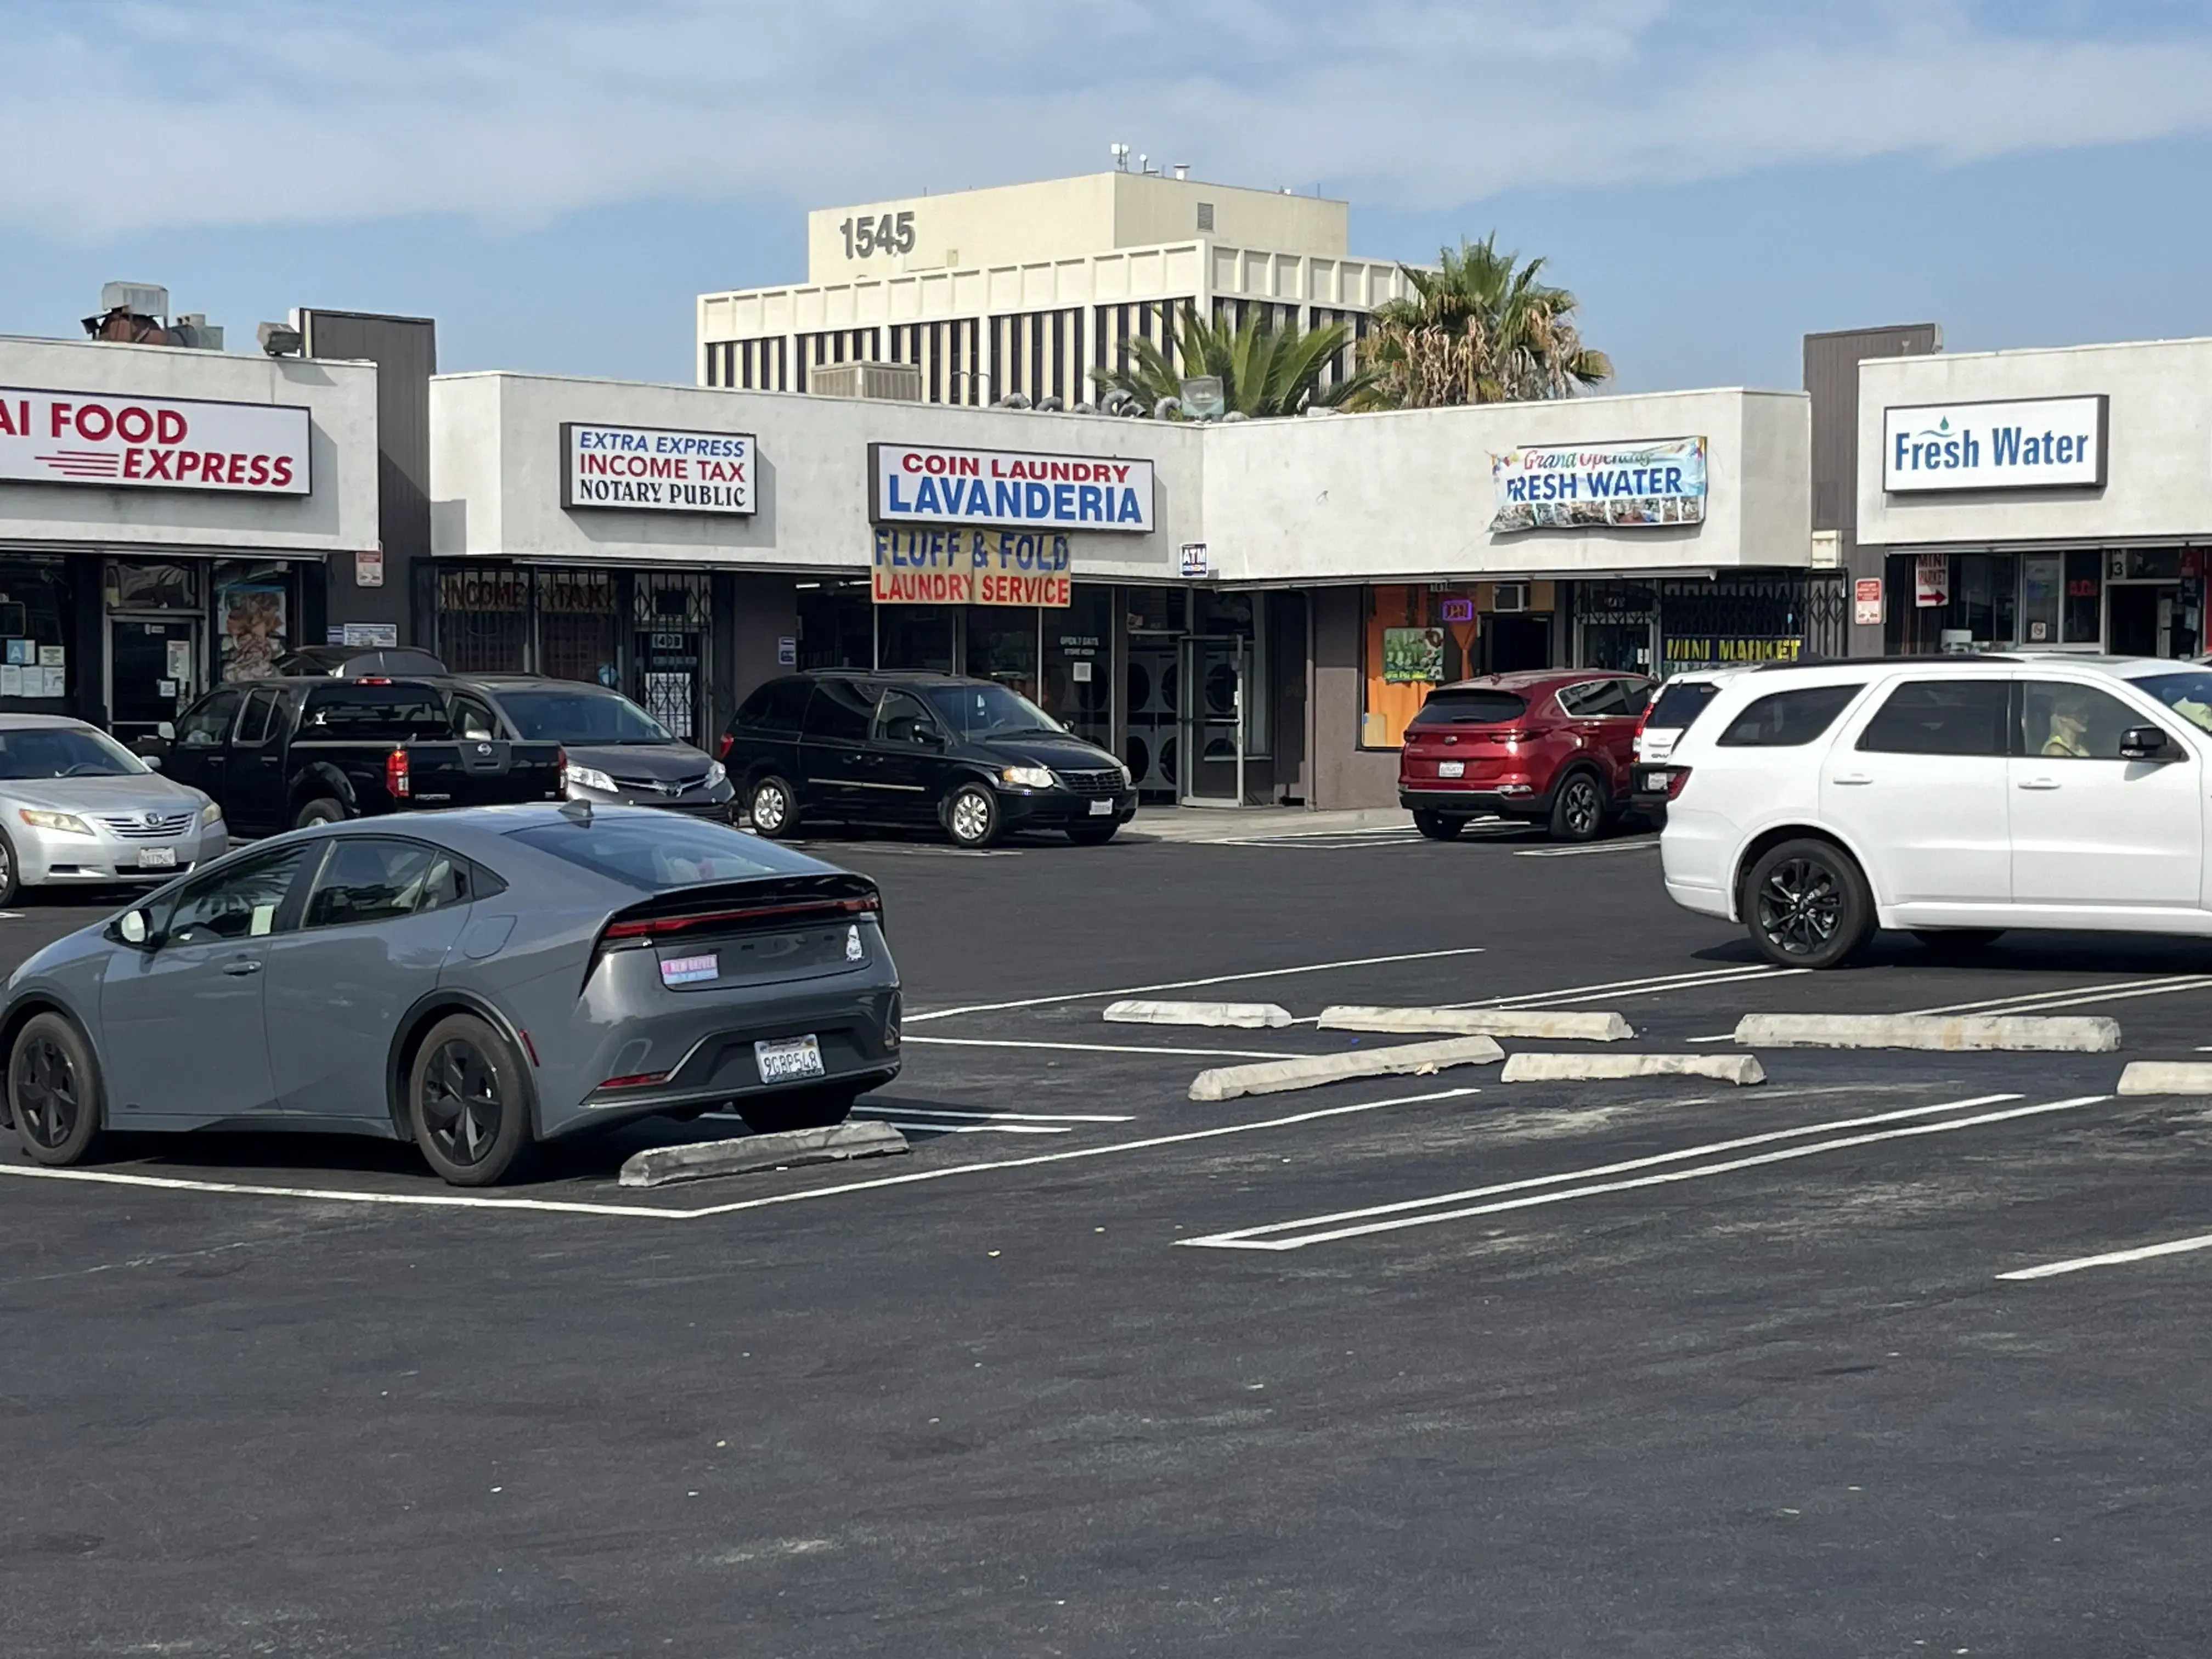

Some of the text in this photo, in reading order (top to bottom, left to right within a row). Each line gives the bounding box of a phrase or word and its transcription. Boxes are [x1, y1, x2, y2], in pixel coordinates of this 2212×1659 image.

[840, 211, 916, 259] 1545
[52, 402, 187, 445] FOOD
[579, 431, 746, 457] EXTRA EXPRESS
[1895, 426, 2089, 470] Fresh Water
[123, 448, 294, 487] EXPRESS
[580, 454, 746, 482] INCOME TAX
[902, 453, 1131, 483] COIN LAUNDRY
[1524, 449, 1578, 470] Grand
[579, 479, 746, 507] NOTARY PUBLIC
[889, 474, 1143, 523] LAVANDERIA
[1506, 467, 1683, 502] FRESH WATER
[874, 528, 1069, 571] FLUFF & FOLD
[1183, 548, 1206, 564] ATM
[1918, 554, 1947, 568] MINI
[444, 580, 527, 607] INCOME
[876, 572, 1070, 605] LAUNDRY SERVICE
[1667, 639, 1802, 662] MINI MARKET
